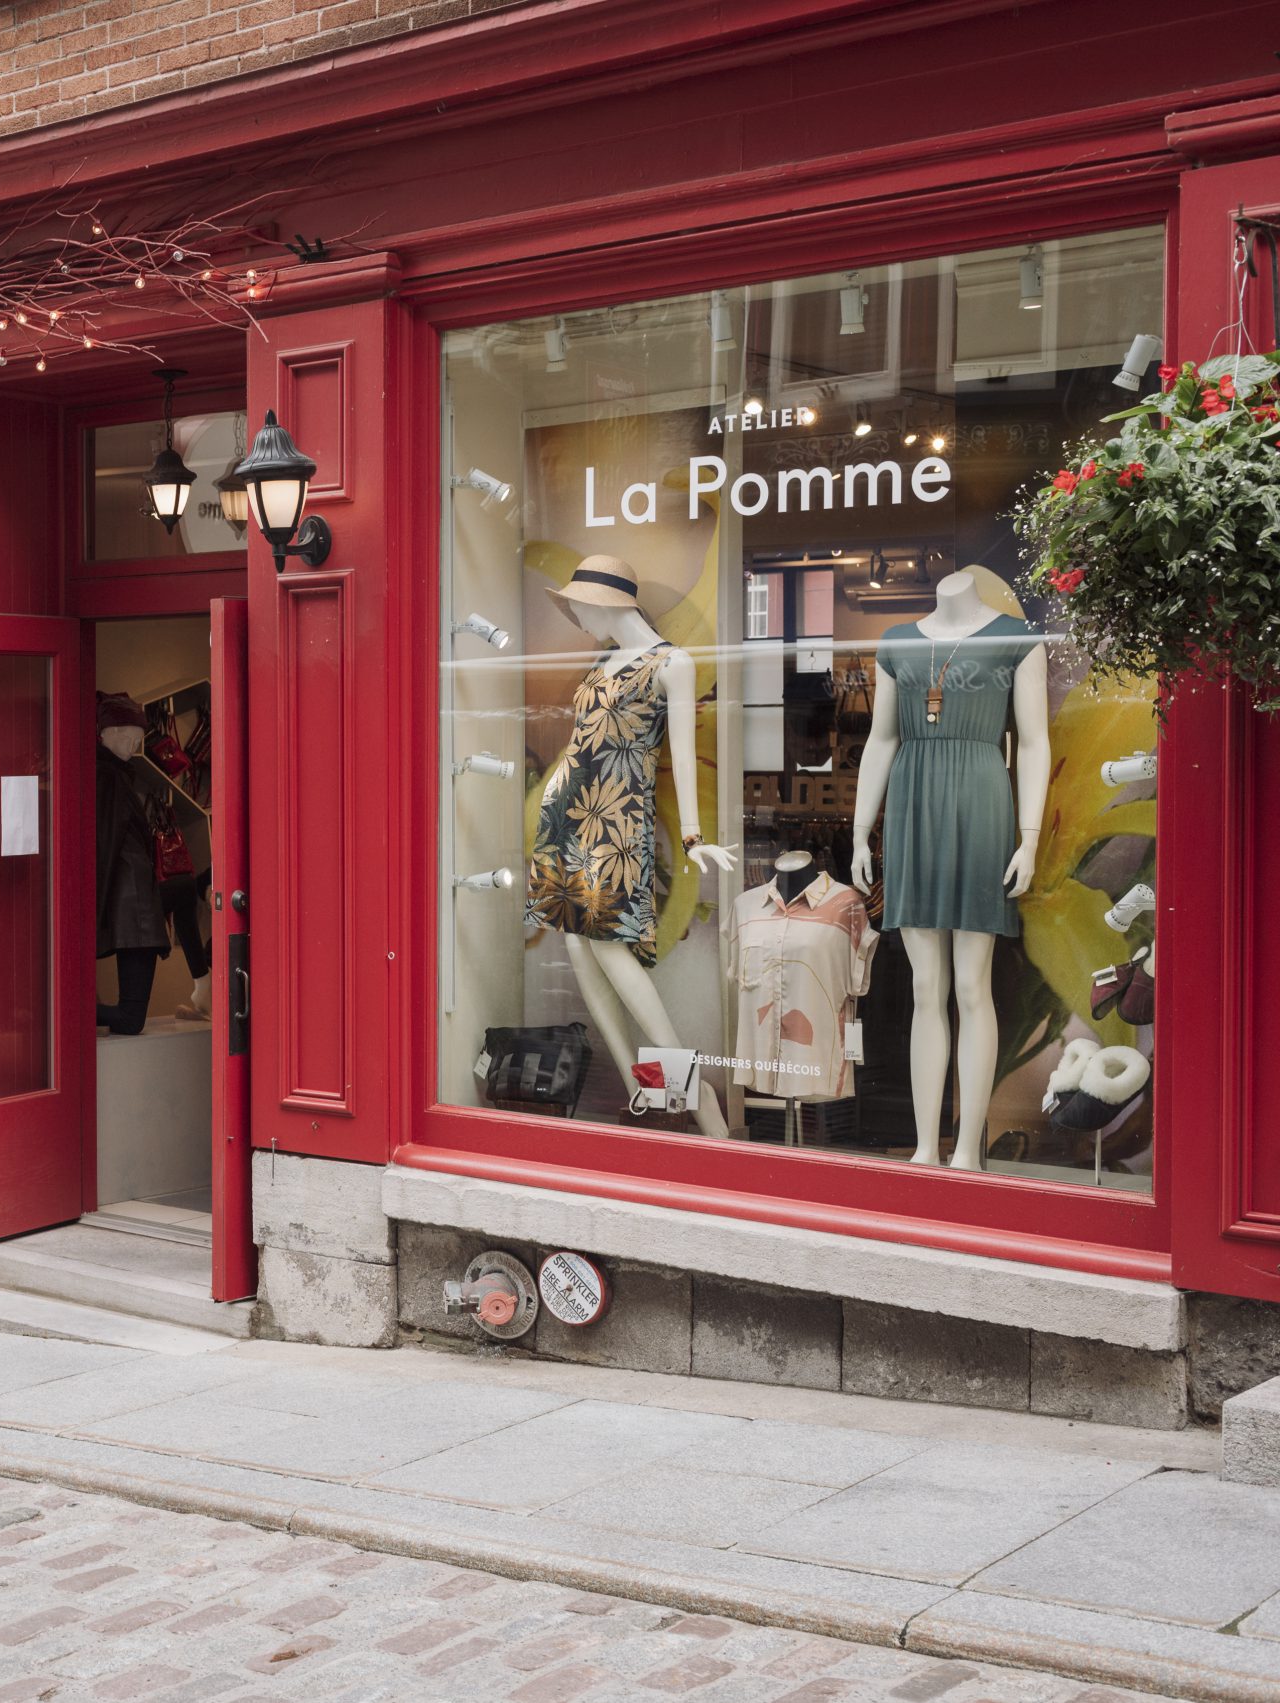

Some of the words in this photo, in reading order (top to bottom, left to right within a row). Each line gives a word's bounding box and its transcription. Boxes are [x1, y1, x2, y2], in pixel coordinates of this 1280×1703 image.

[707, 406, 810, 435] ATELIER
[585, 466, 656, 527] La
[689, 455, 951, 520] Pomme
[690, 1054, 751, 1069] DESIGNERS
[754, 1059, 821, 1076] QUÉBÉCOIS
[542, 1266, 590, 1321] FIRE-ALARM
[552, 1255, 599, 1308] SPRINKLER
